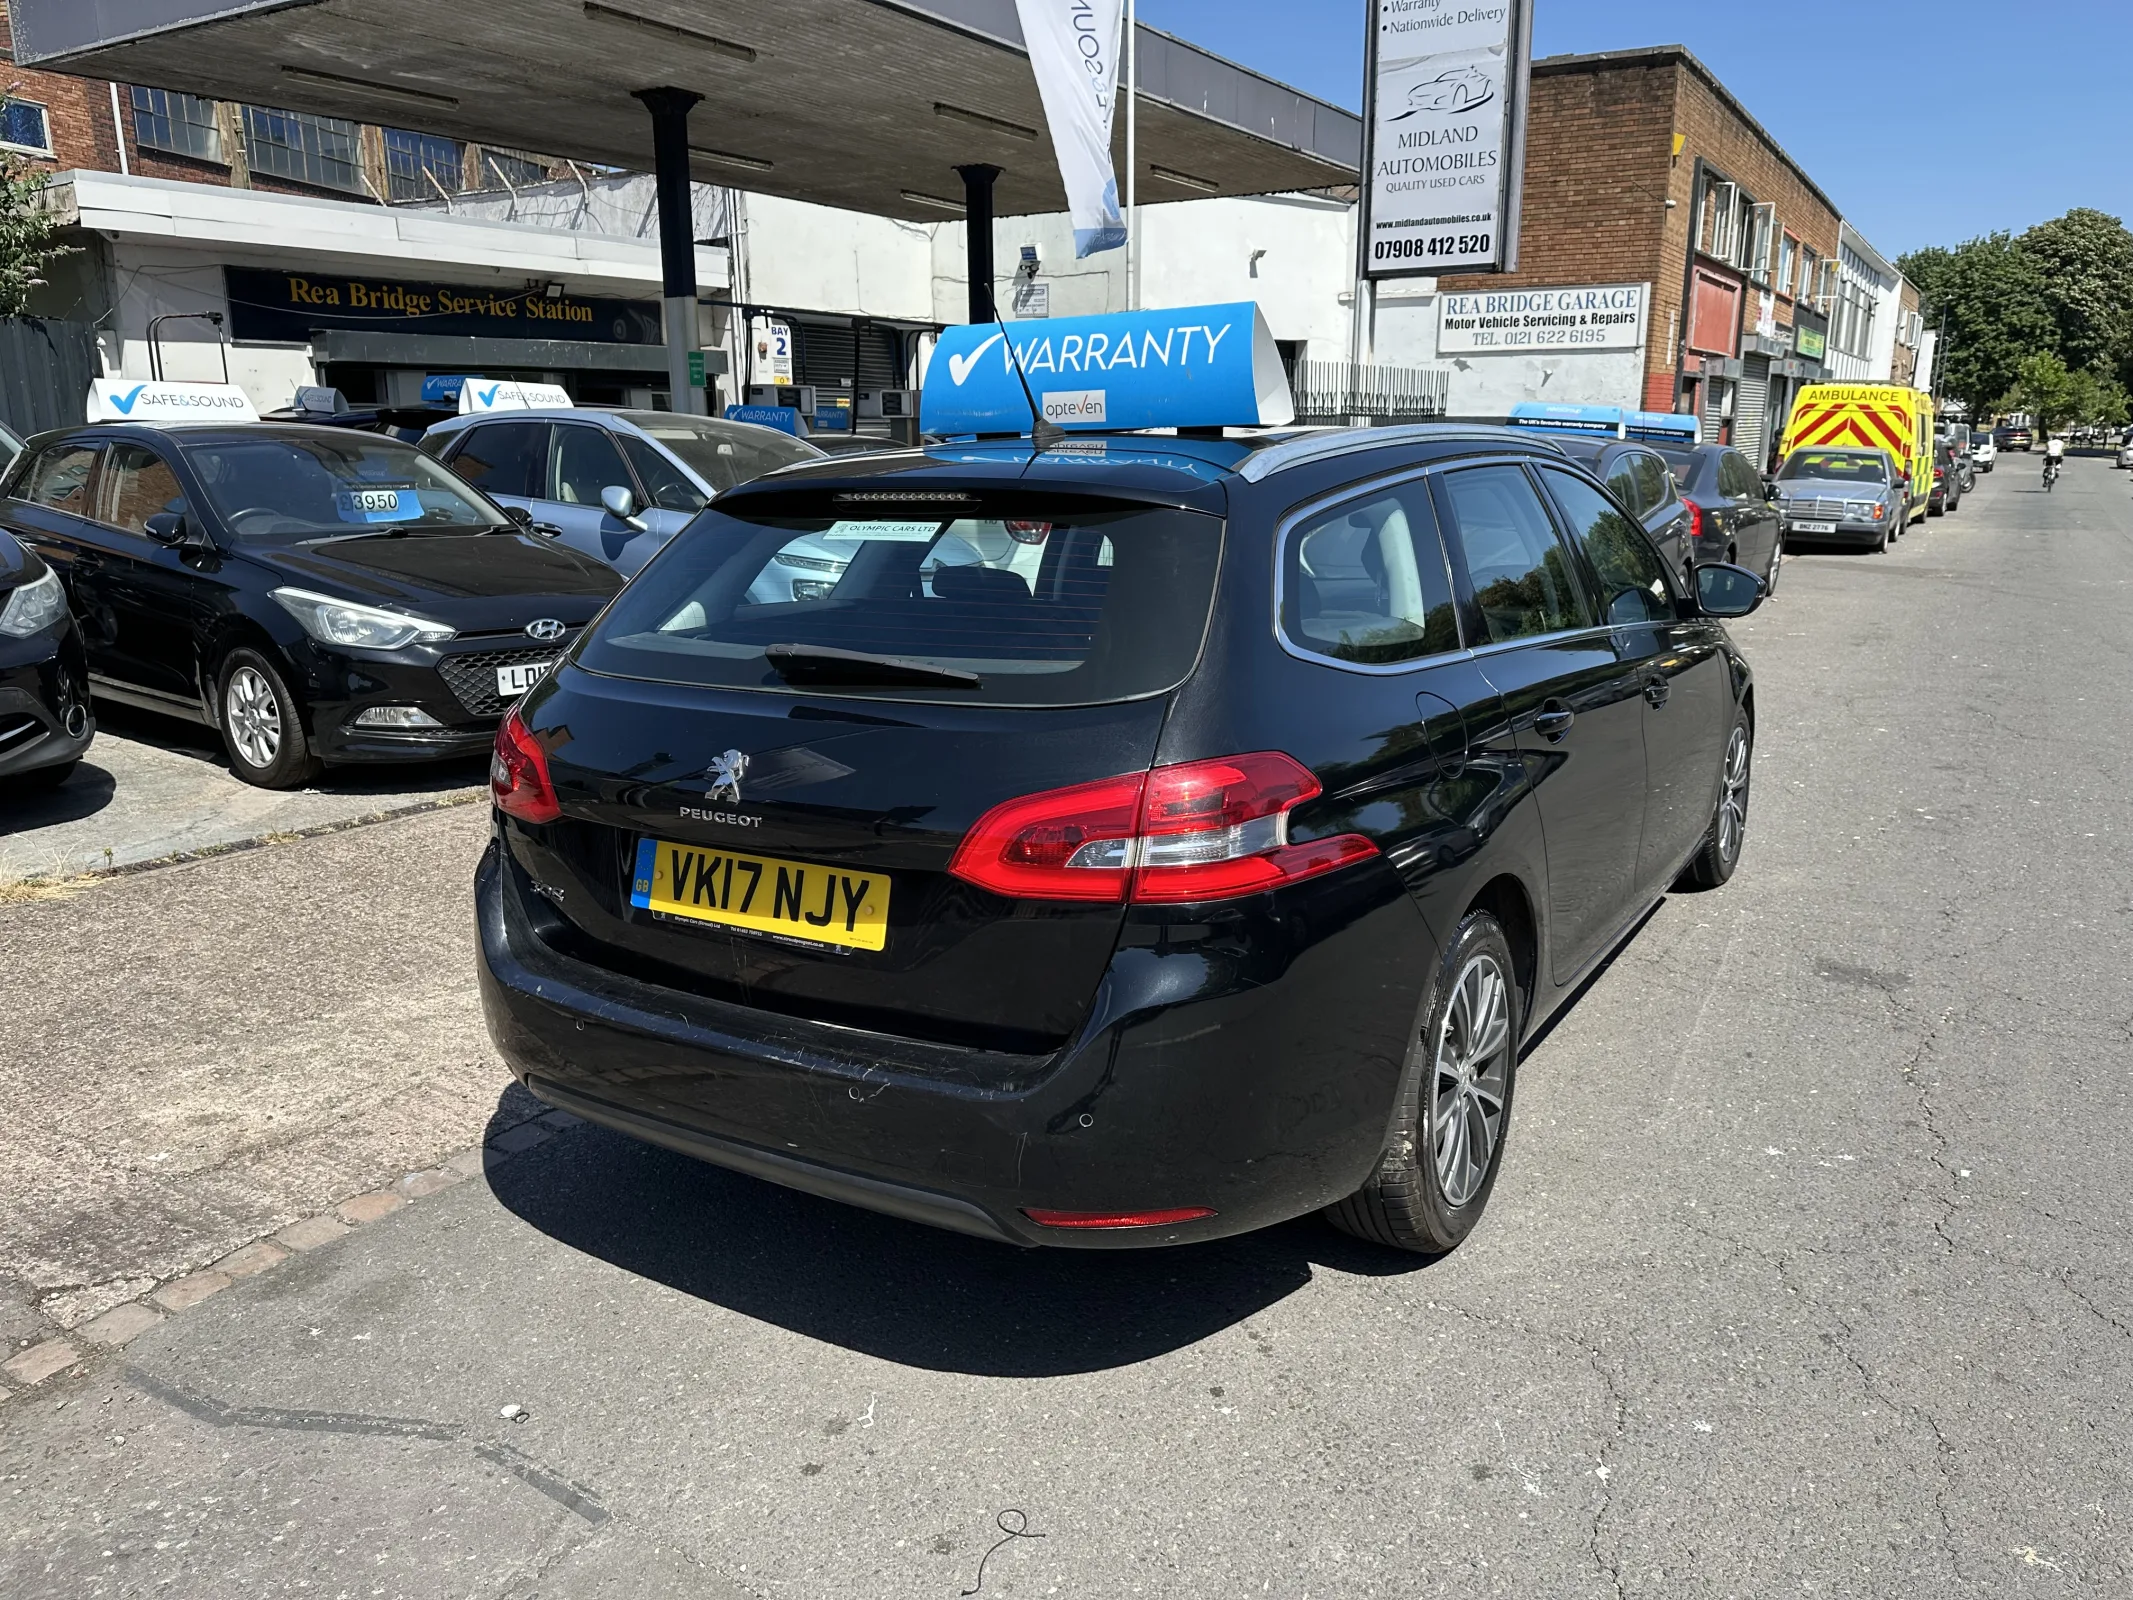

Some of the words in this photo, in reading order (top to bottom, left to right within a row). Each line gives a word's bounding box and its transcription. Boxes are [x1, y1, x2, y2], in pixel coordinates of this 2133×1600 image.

[1390, 13, 1453, 34] Nationwide
[1457, 7, 1506, 24] Delivery
[1398, 125, 1479, 149] MIDLAND
[1377, 150, 1497, 176] AUTOMOBILES
[1385, 179, 1427, 194] QUALITY
[1429, 177, 1456, 189] USED
[1458, 174, 1485, 186] CARS
[1376, 212, 1491, 230] www.midlandautomobiles.co.uk
[1375, 238, 1423, 260] 07908
[1427, 236, 1455, 256] 412
[1458, 234, 1490, 254] 520
[287, 277, 340, 305] Rea
[348, 282, 431, 317] Bridge
[438, 290, 517, 317] Service
[526, 296, 594, 322] Station
[1446, 297, 1480, 315] REA
[1486, 293, 1553, 313] BRIDGE
[1558, 290, 1637, 311] GARAGE
[1445, 317, 1476, 330] Motor
[1479, 315, 1520, 329] Vehicle
[1523, 313, 1576, 327] Servicing
[1580, 314, 1587, 325] &
[1591, 312, 1636, 326] Repairs
[771, 326, 789, 336] BAY
[1472, 332, 1500, 346] TEL.
[1504, 331, 1531, 345] 0121
[1536, 330, 1565, 344] 622
[1569, 329, 1606, 343] 6195
[776, 337, 787, 356] 2
[1003, 323, 1231, 376] WARRANTY
[436, 376, 465, 388] WARRA
[141, 392, 244, 409] SAFE&SOUND
[497, 390, 566, 404] SAFE&SOUND
[1808, 390, 1899, 402] AMBULANCE
[1046, 394, 1102, 419] opteven
[741, 410, 790, 423] WARRANTY
[679, 806, 763, 828] PEUGEOT
[635, 879, 649, 894] GB
[672, 850, 763, 913] VK17
[772, 866, 870, 932] NJY
